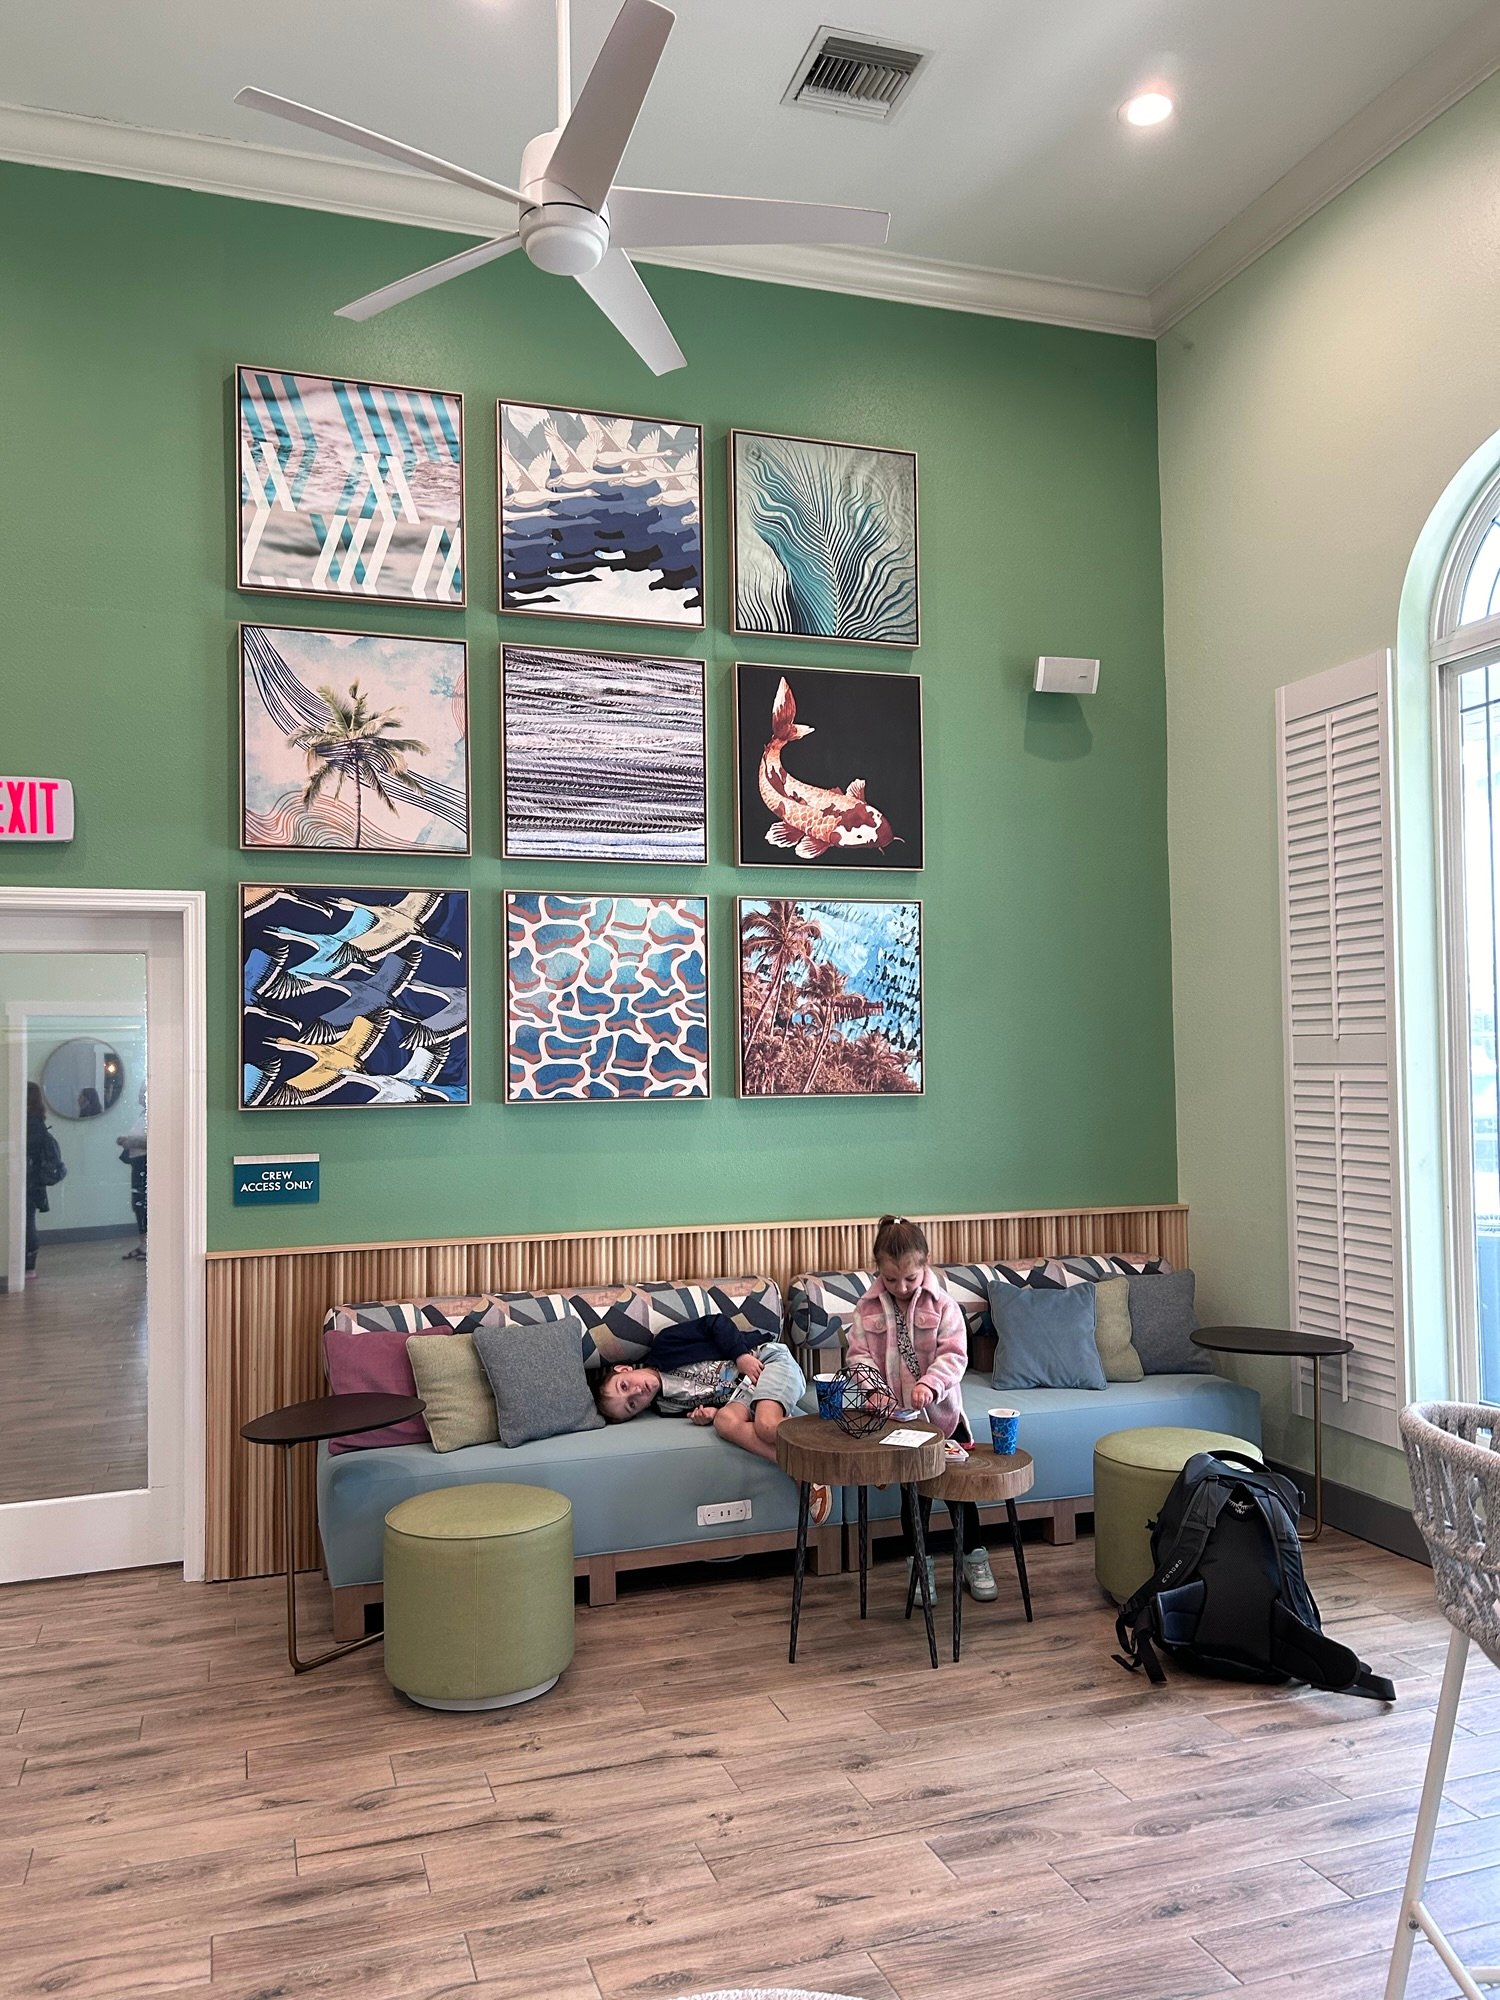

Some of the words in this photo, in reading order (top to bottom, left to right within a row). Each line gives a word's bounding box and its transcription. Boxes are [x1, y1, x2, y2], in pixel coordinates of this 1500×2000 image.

[261, 1171, 292, 1180] CREW
[240, 1182, 281, 1192] ACCESS
[285, 1181, 313, 1190] ONLY
